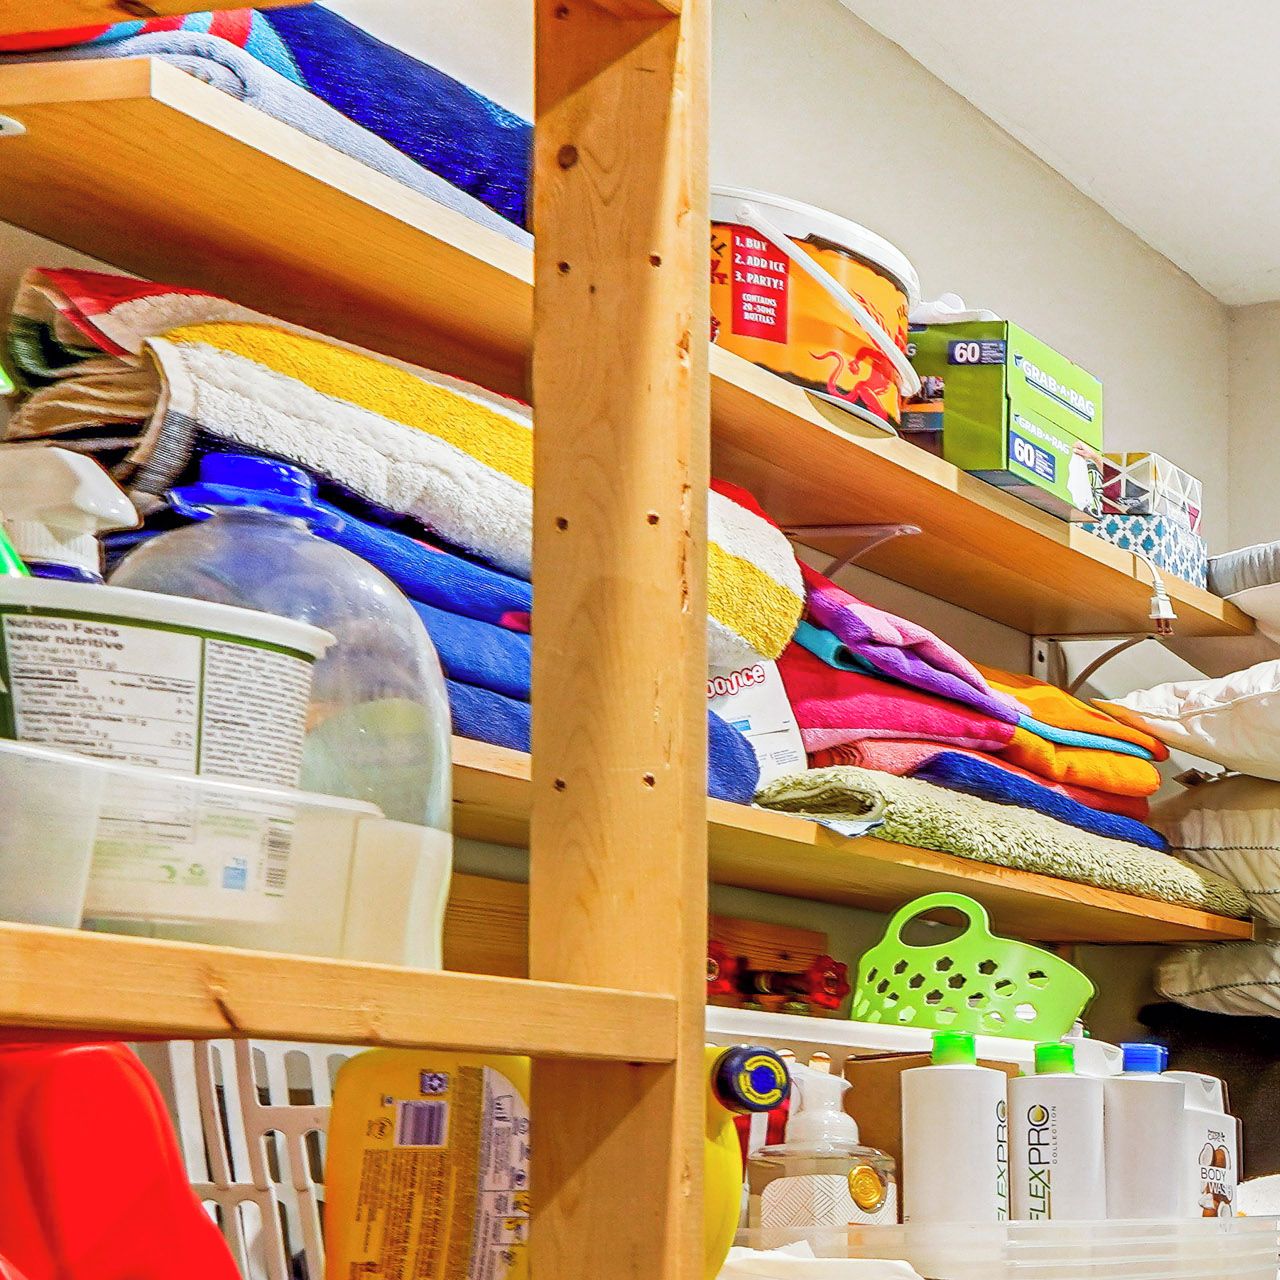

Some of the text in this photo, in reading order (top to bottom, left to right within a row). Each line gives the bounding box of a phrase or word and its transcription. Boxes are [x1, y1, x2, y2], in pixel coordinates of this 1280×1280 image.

[746, 236, 768, 252] BUY
[746, 255, 768, 270] ADD
[769, 260, 787, 274] ICE
[746, 271, 785, 291] PARTY!
[954, 342, 981, 364] 60
[1014, 439, 1035, 468] 60
[1200, 1167, 1227, 1181] BODY
